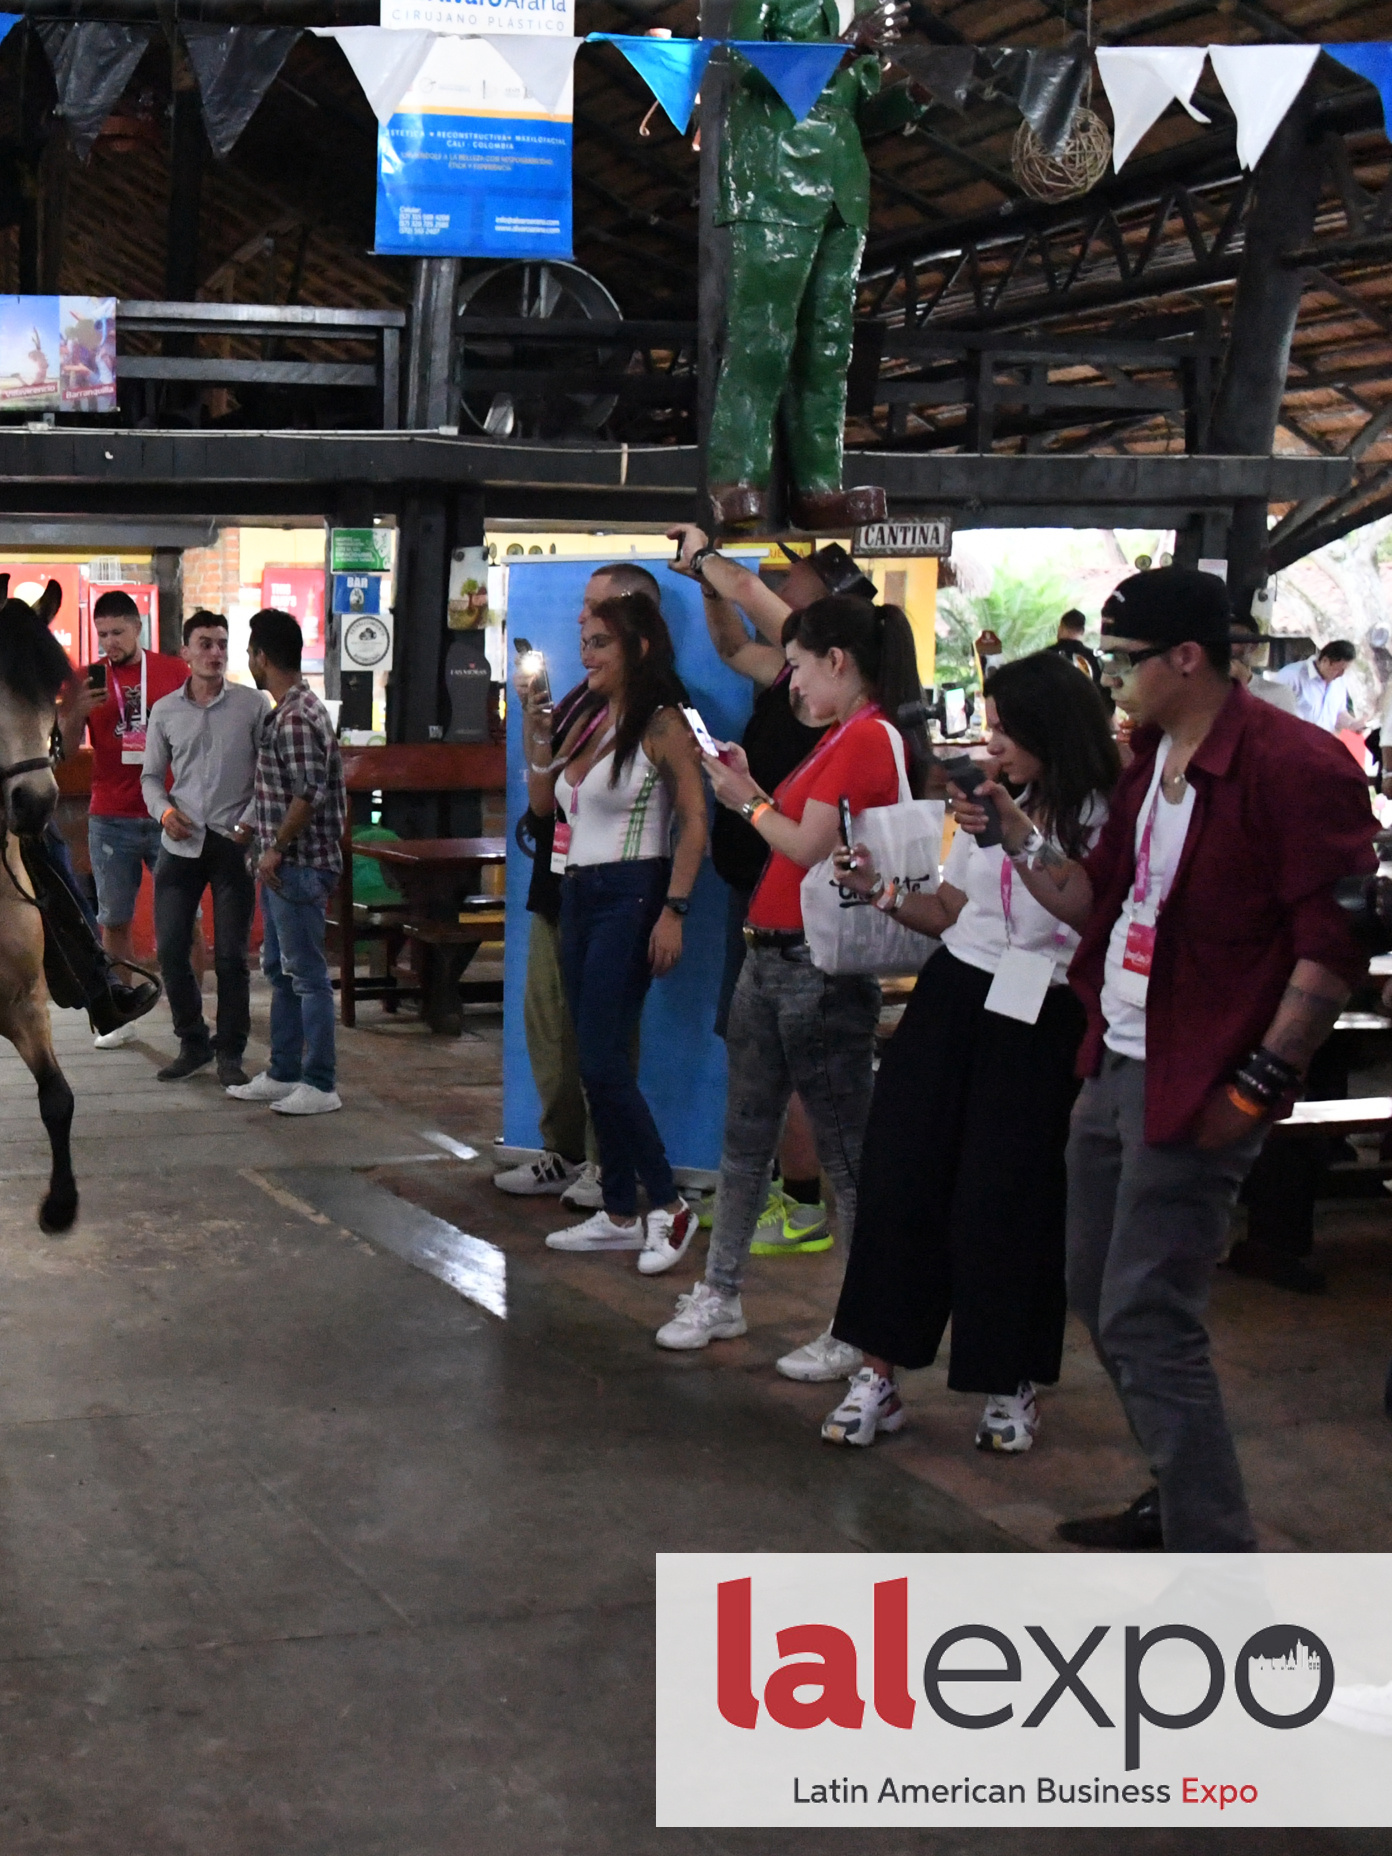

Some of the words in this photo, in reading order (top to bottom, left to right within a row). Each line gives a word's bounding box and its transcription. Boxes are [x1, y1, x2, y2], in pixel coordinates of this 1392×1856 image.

[391, 9, 478, 25] CIRUJANO
[446, 140, 466, 148] CALI
[472, 141, 515, 150] COLOMBIA
[65, 386, 115, 399] Barranquilla
[864, 523, 941, 546] CANTINA
[346, 576, 368, 589] BAR
